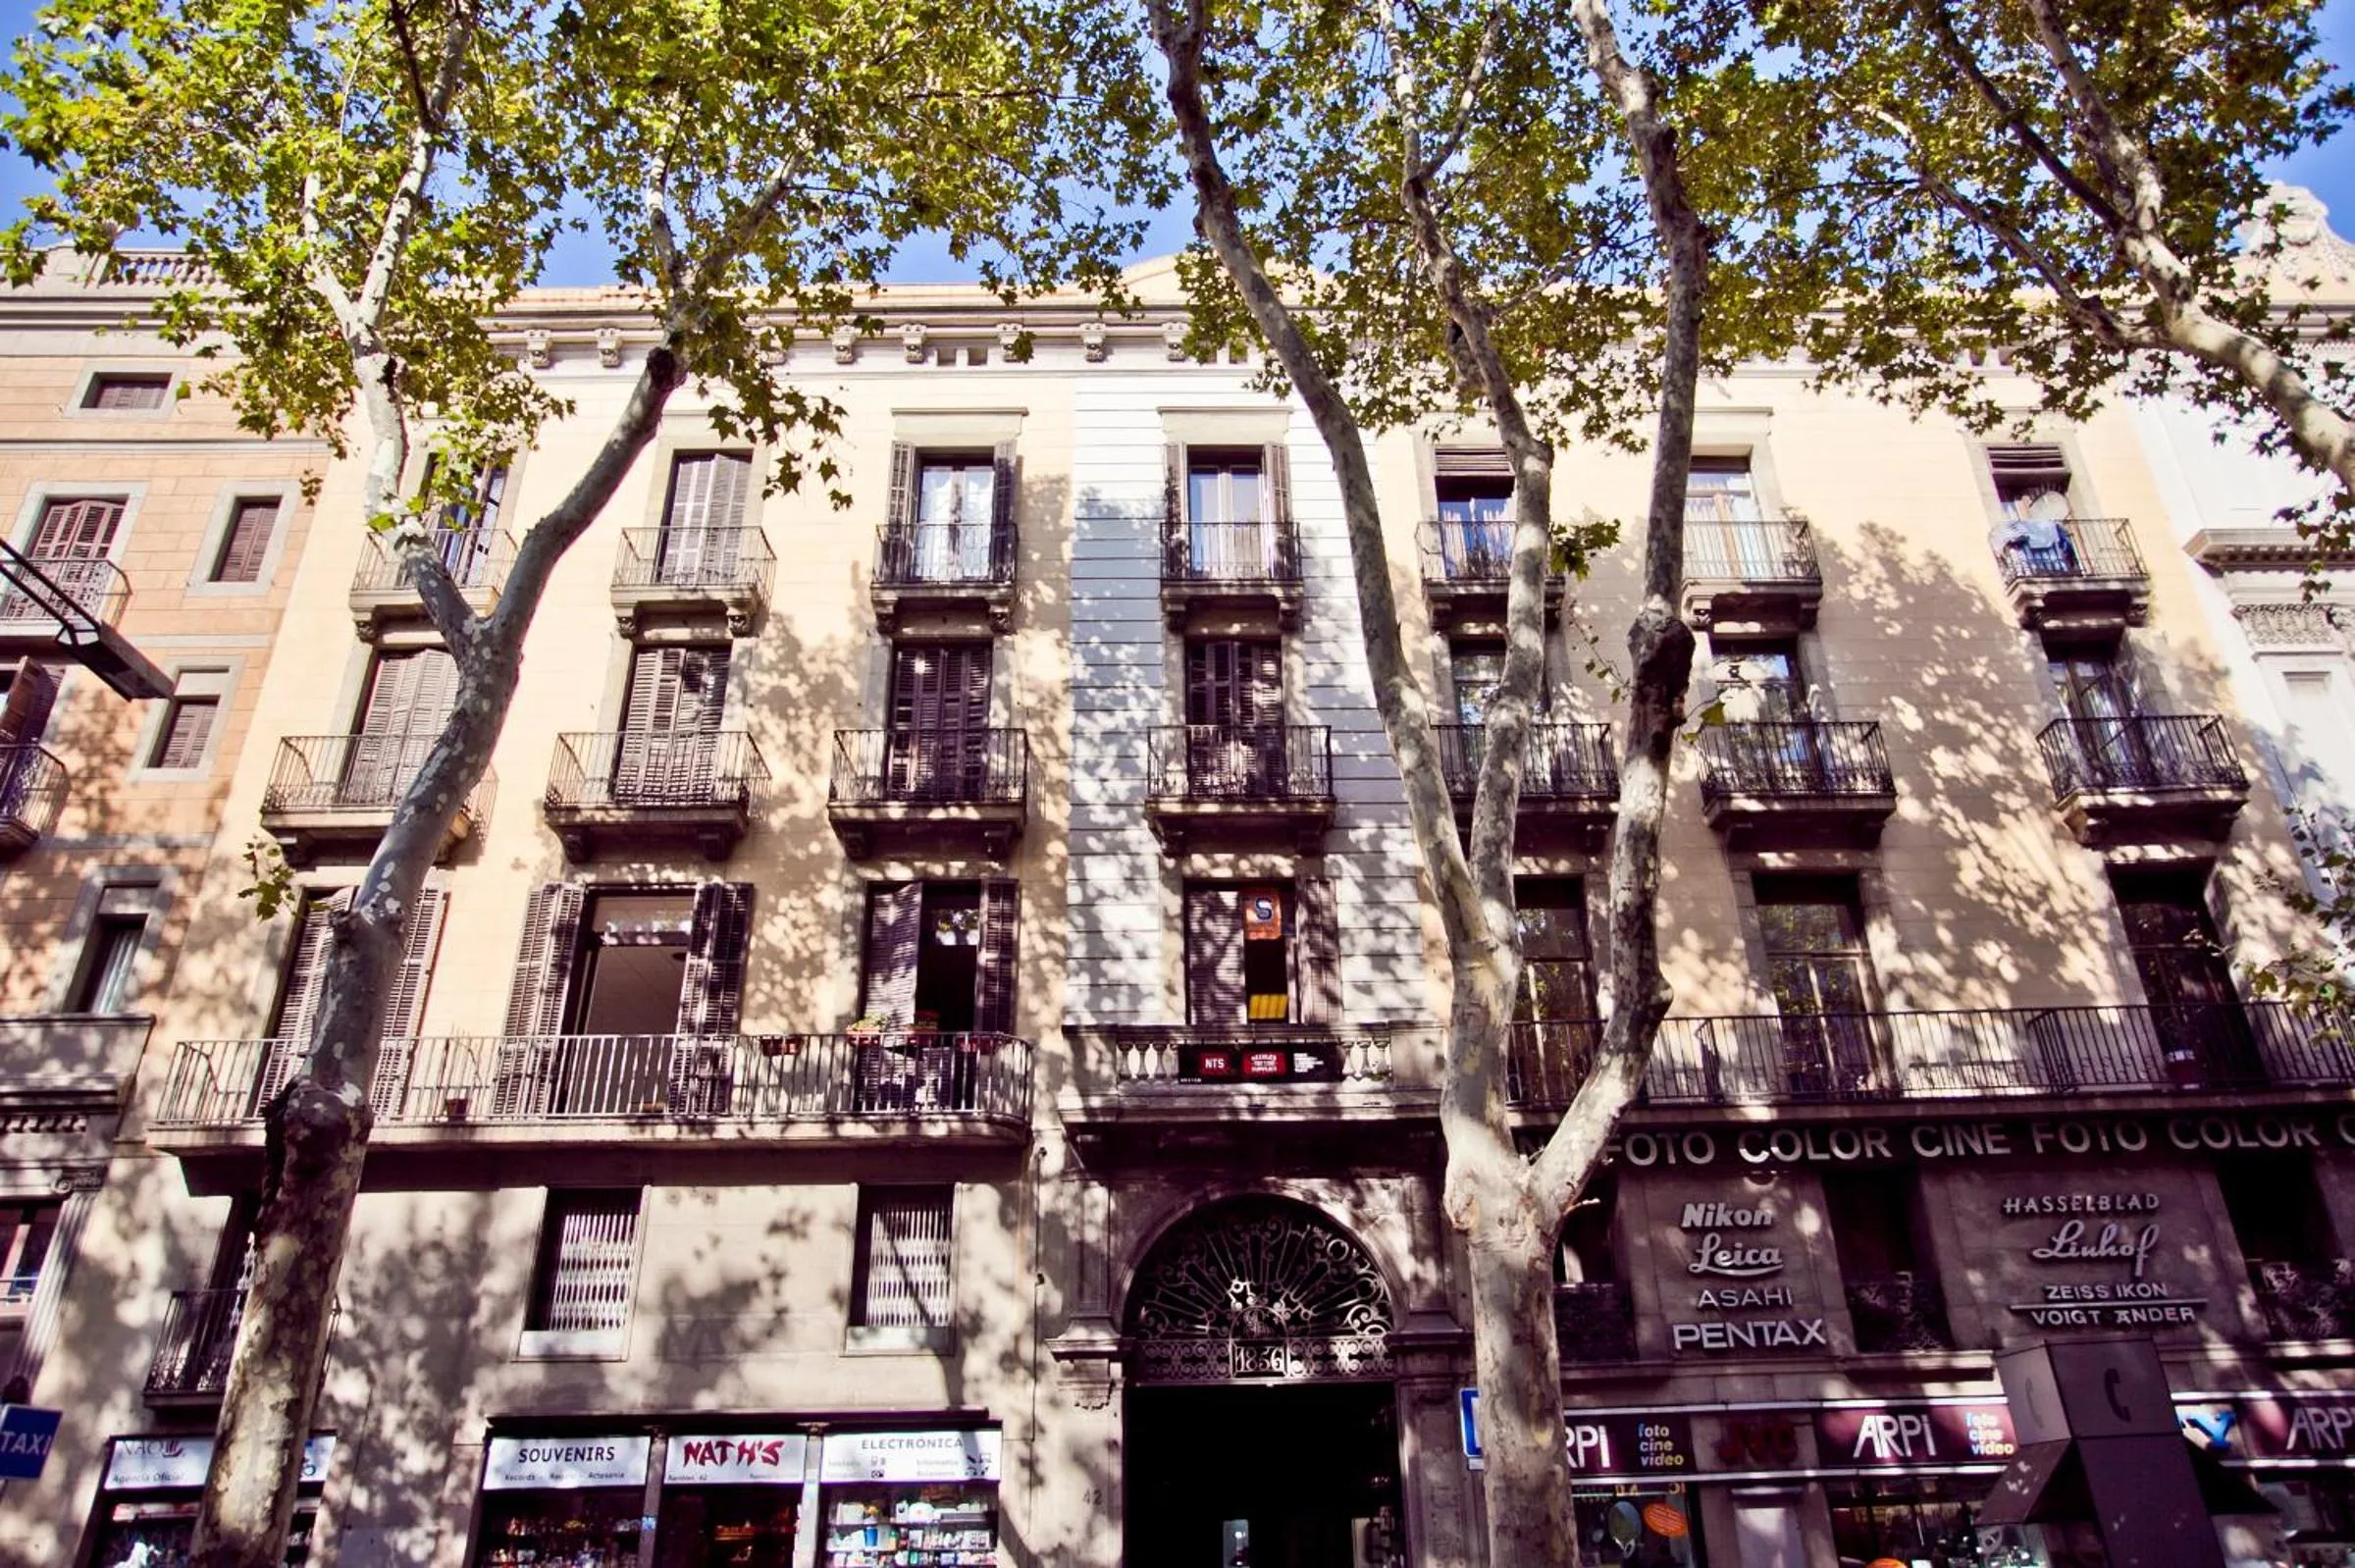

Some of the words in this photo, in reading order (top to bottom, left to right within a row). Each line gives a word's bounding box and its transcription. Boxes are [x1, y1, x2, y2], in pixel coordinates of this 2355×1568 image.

[1205, 1058, 1225, 1069] NTS
[1738, 1126, 1892, 1164] COLOR
[1911, 1124, 2012, 1158] CINE
[2033, 1119, 2147, 1154] FOTO
[2168, 1116, 2321, 1151] COLOR
[2003, 1193, 2159, 1214] HASSELBLAD
[1681, 1202, 1774, 1228] Nikon
[1688, 1232, 1784, 1276] Leica
[1697, 1288, 1794, 1308] ASAHI
[2045, 1284, 2110, 1300] ZEISS
[2115, 1282, 2168, 1298] IKON
[1673, 1319, 1828, 1350] PENTAX
[1637, 1422, 1670, 1438] foto
[1853, 1414, 1938, 1459] ARPI
[1, 1431, 52, 1456] TAXI
[1640, 1437, 1674, 1452] cine
[1971, 1440, 2015, 1455] video
[518, 1446, 616, 1463] SOUVENIRS
[1640, 1452, 1685, 1467] video
